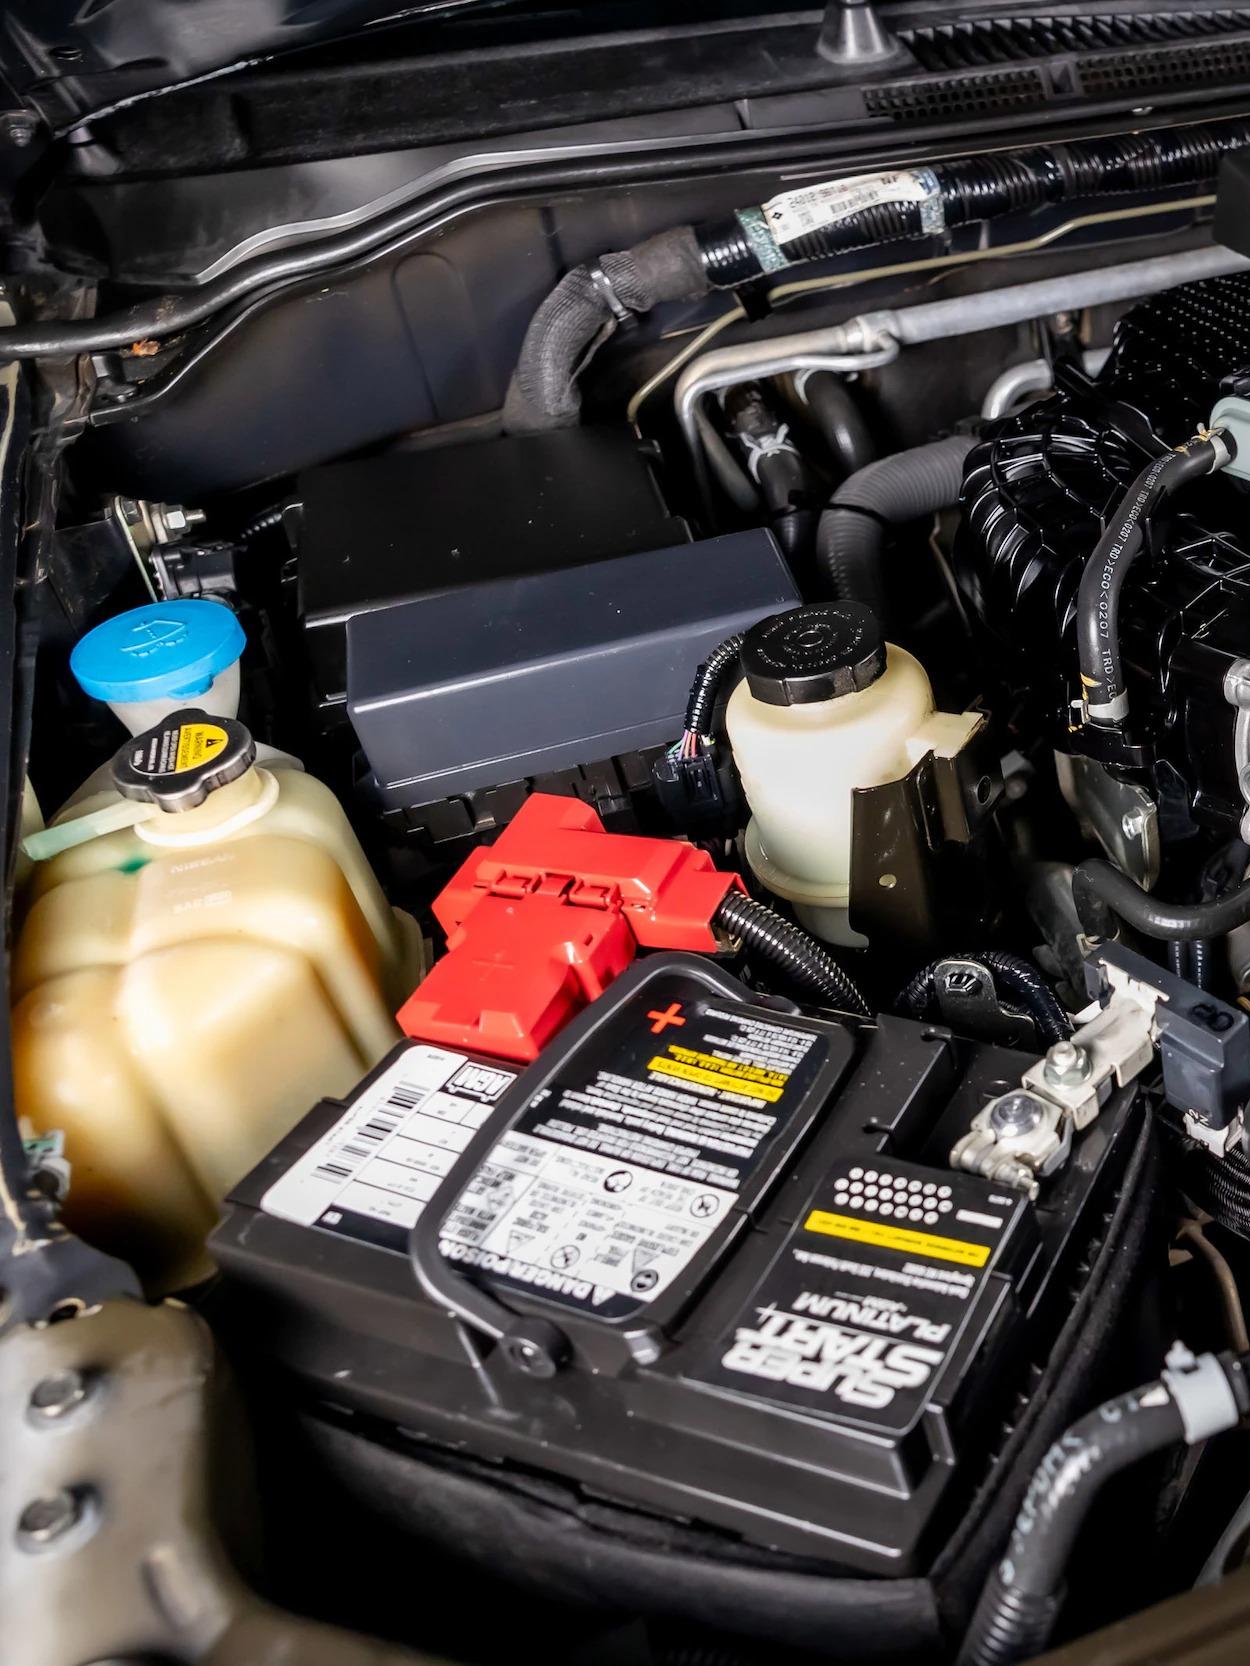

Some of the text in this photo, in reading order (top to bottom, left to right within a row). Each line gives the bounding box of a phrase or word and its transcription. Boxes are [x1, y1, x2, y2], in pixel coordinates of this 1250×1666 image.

[453, 1066, 512, 1096] AGM
[510, 1259, 594, 1300] DANGER
[791, 1290, 953, 1344] PLATINUM
[720, 1340, 896, 1410] SUPER
[734, 1312, 946, 1390] START
